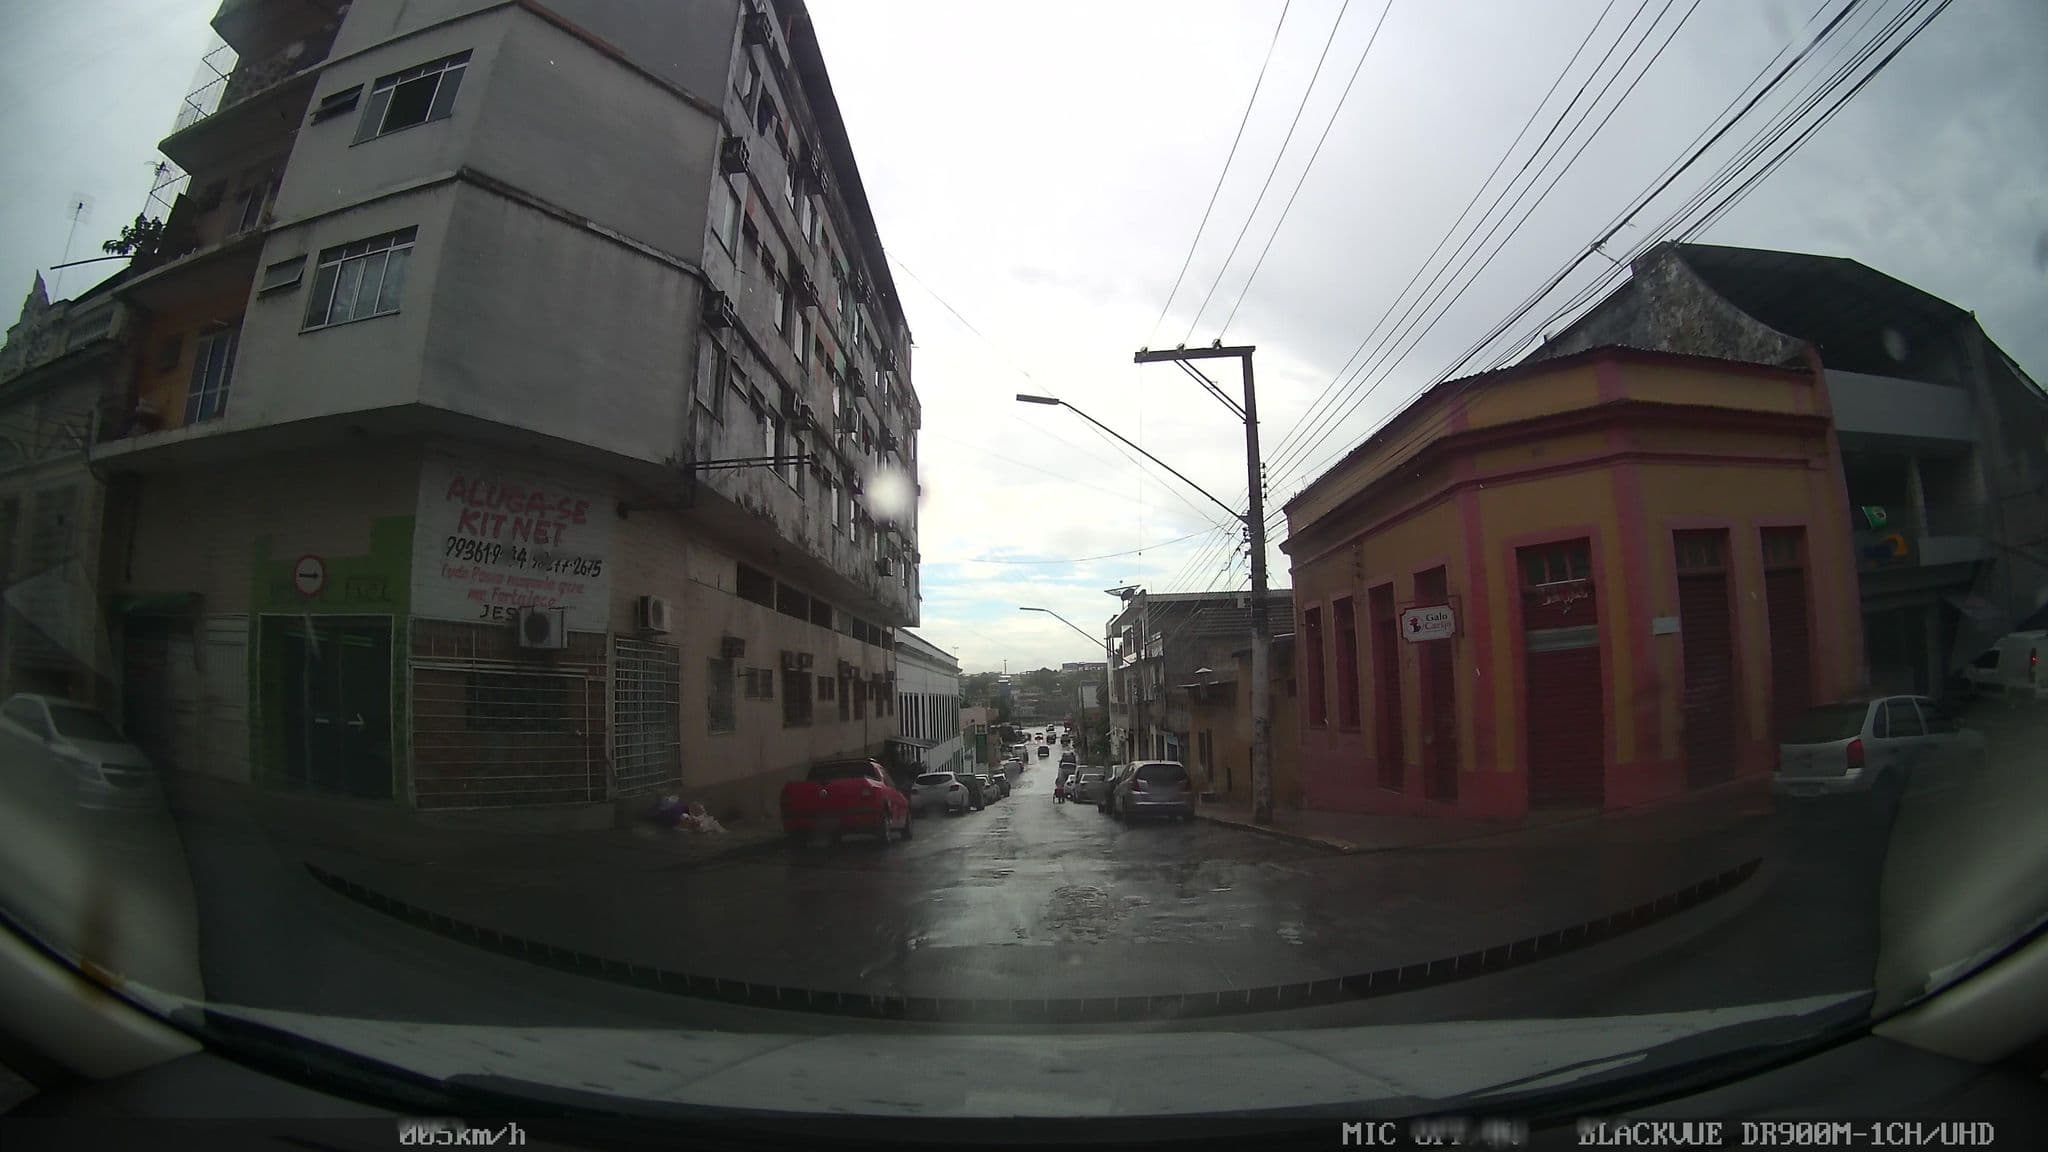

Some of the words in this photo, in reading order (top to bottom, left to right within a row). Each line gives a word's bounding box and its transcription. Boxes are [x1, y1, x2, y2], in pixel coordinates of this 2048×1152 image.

[446, 475, 591, 524] ALUGA-SE
[458, 508, 506, 539] KIT
[512, 516, 566, 547] NET
[1425, 611, 1448, 622] Galo
